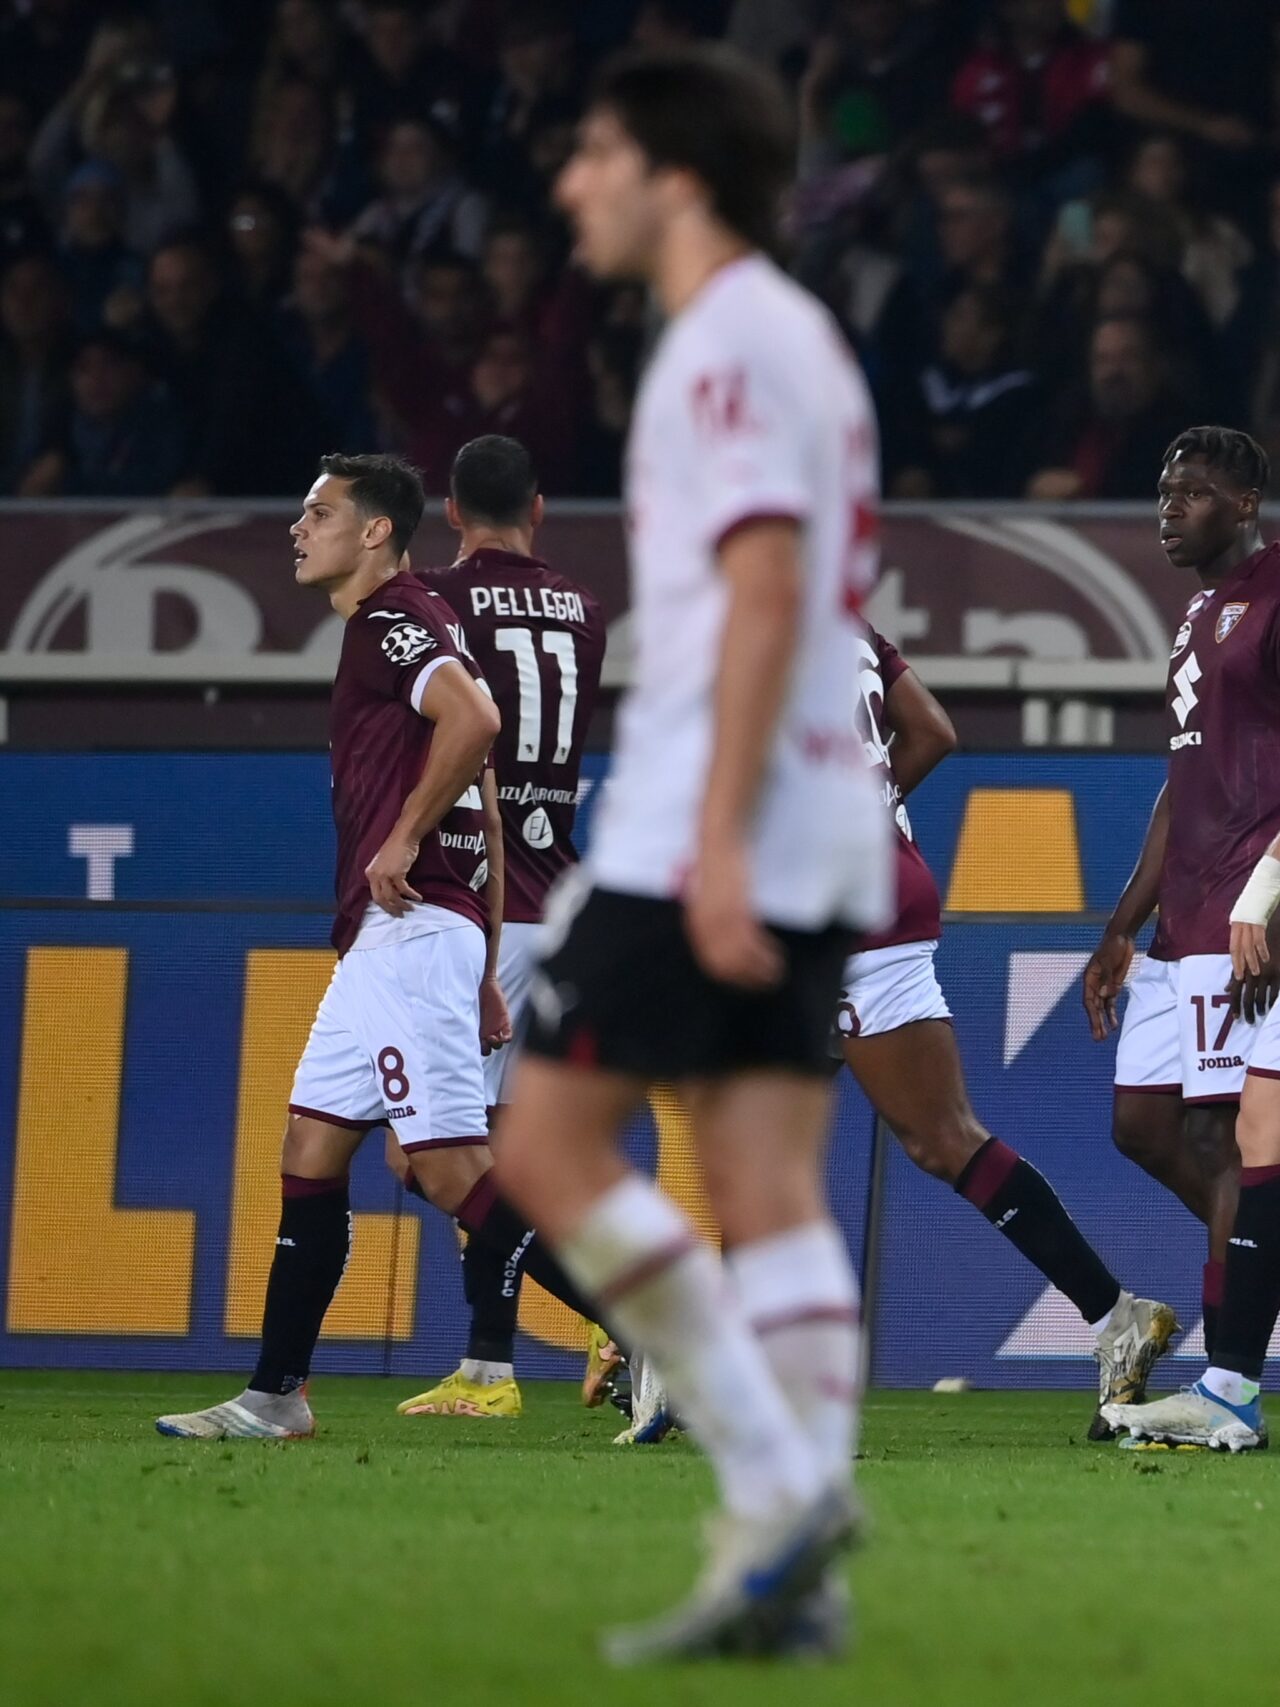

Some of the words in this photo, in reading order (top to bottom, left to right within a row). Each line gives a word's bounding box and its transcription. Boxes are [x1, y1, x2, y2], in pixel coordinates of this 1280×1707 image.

[470, 587, 585, 623] PELLEGRI
[495, 627, 578, 765] 11
[1190, 994, 1236, 1053] 17
[378, 1045, 411, 1103] 8
[386, 1105, 417, 1119] oma
